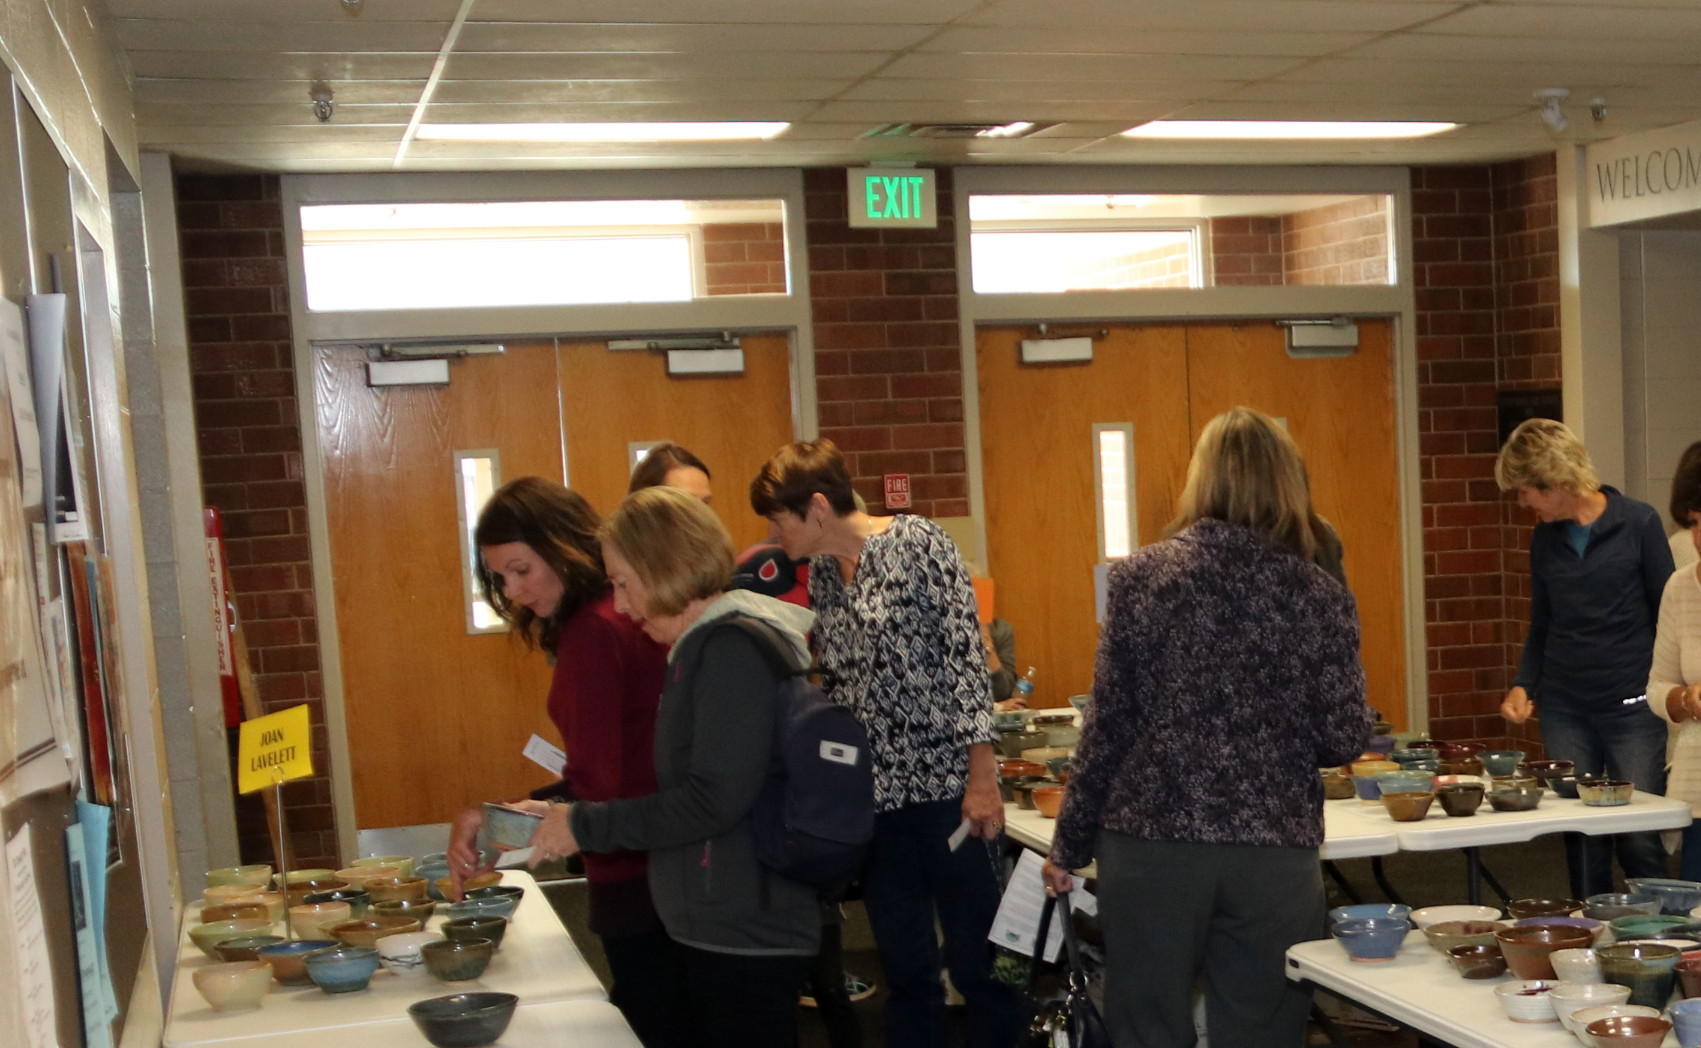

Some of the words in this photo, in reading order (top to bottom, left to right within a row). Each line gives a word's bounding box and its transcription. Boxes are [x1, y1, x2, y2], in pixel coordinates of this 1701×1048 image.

[865, 175, 924, 219] EXIT
[886, 478, 908, 492] FIRE
[207, 542, 217, 574] FIRE
[210, 576, 226, 671] EXTINGUISHER
[260, 727, 284, 747] JOAN
[251, 745, 297, 772] LAVELETT
